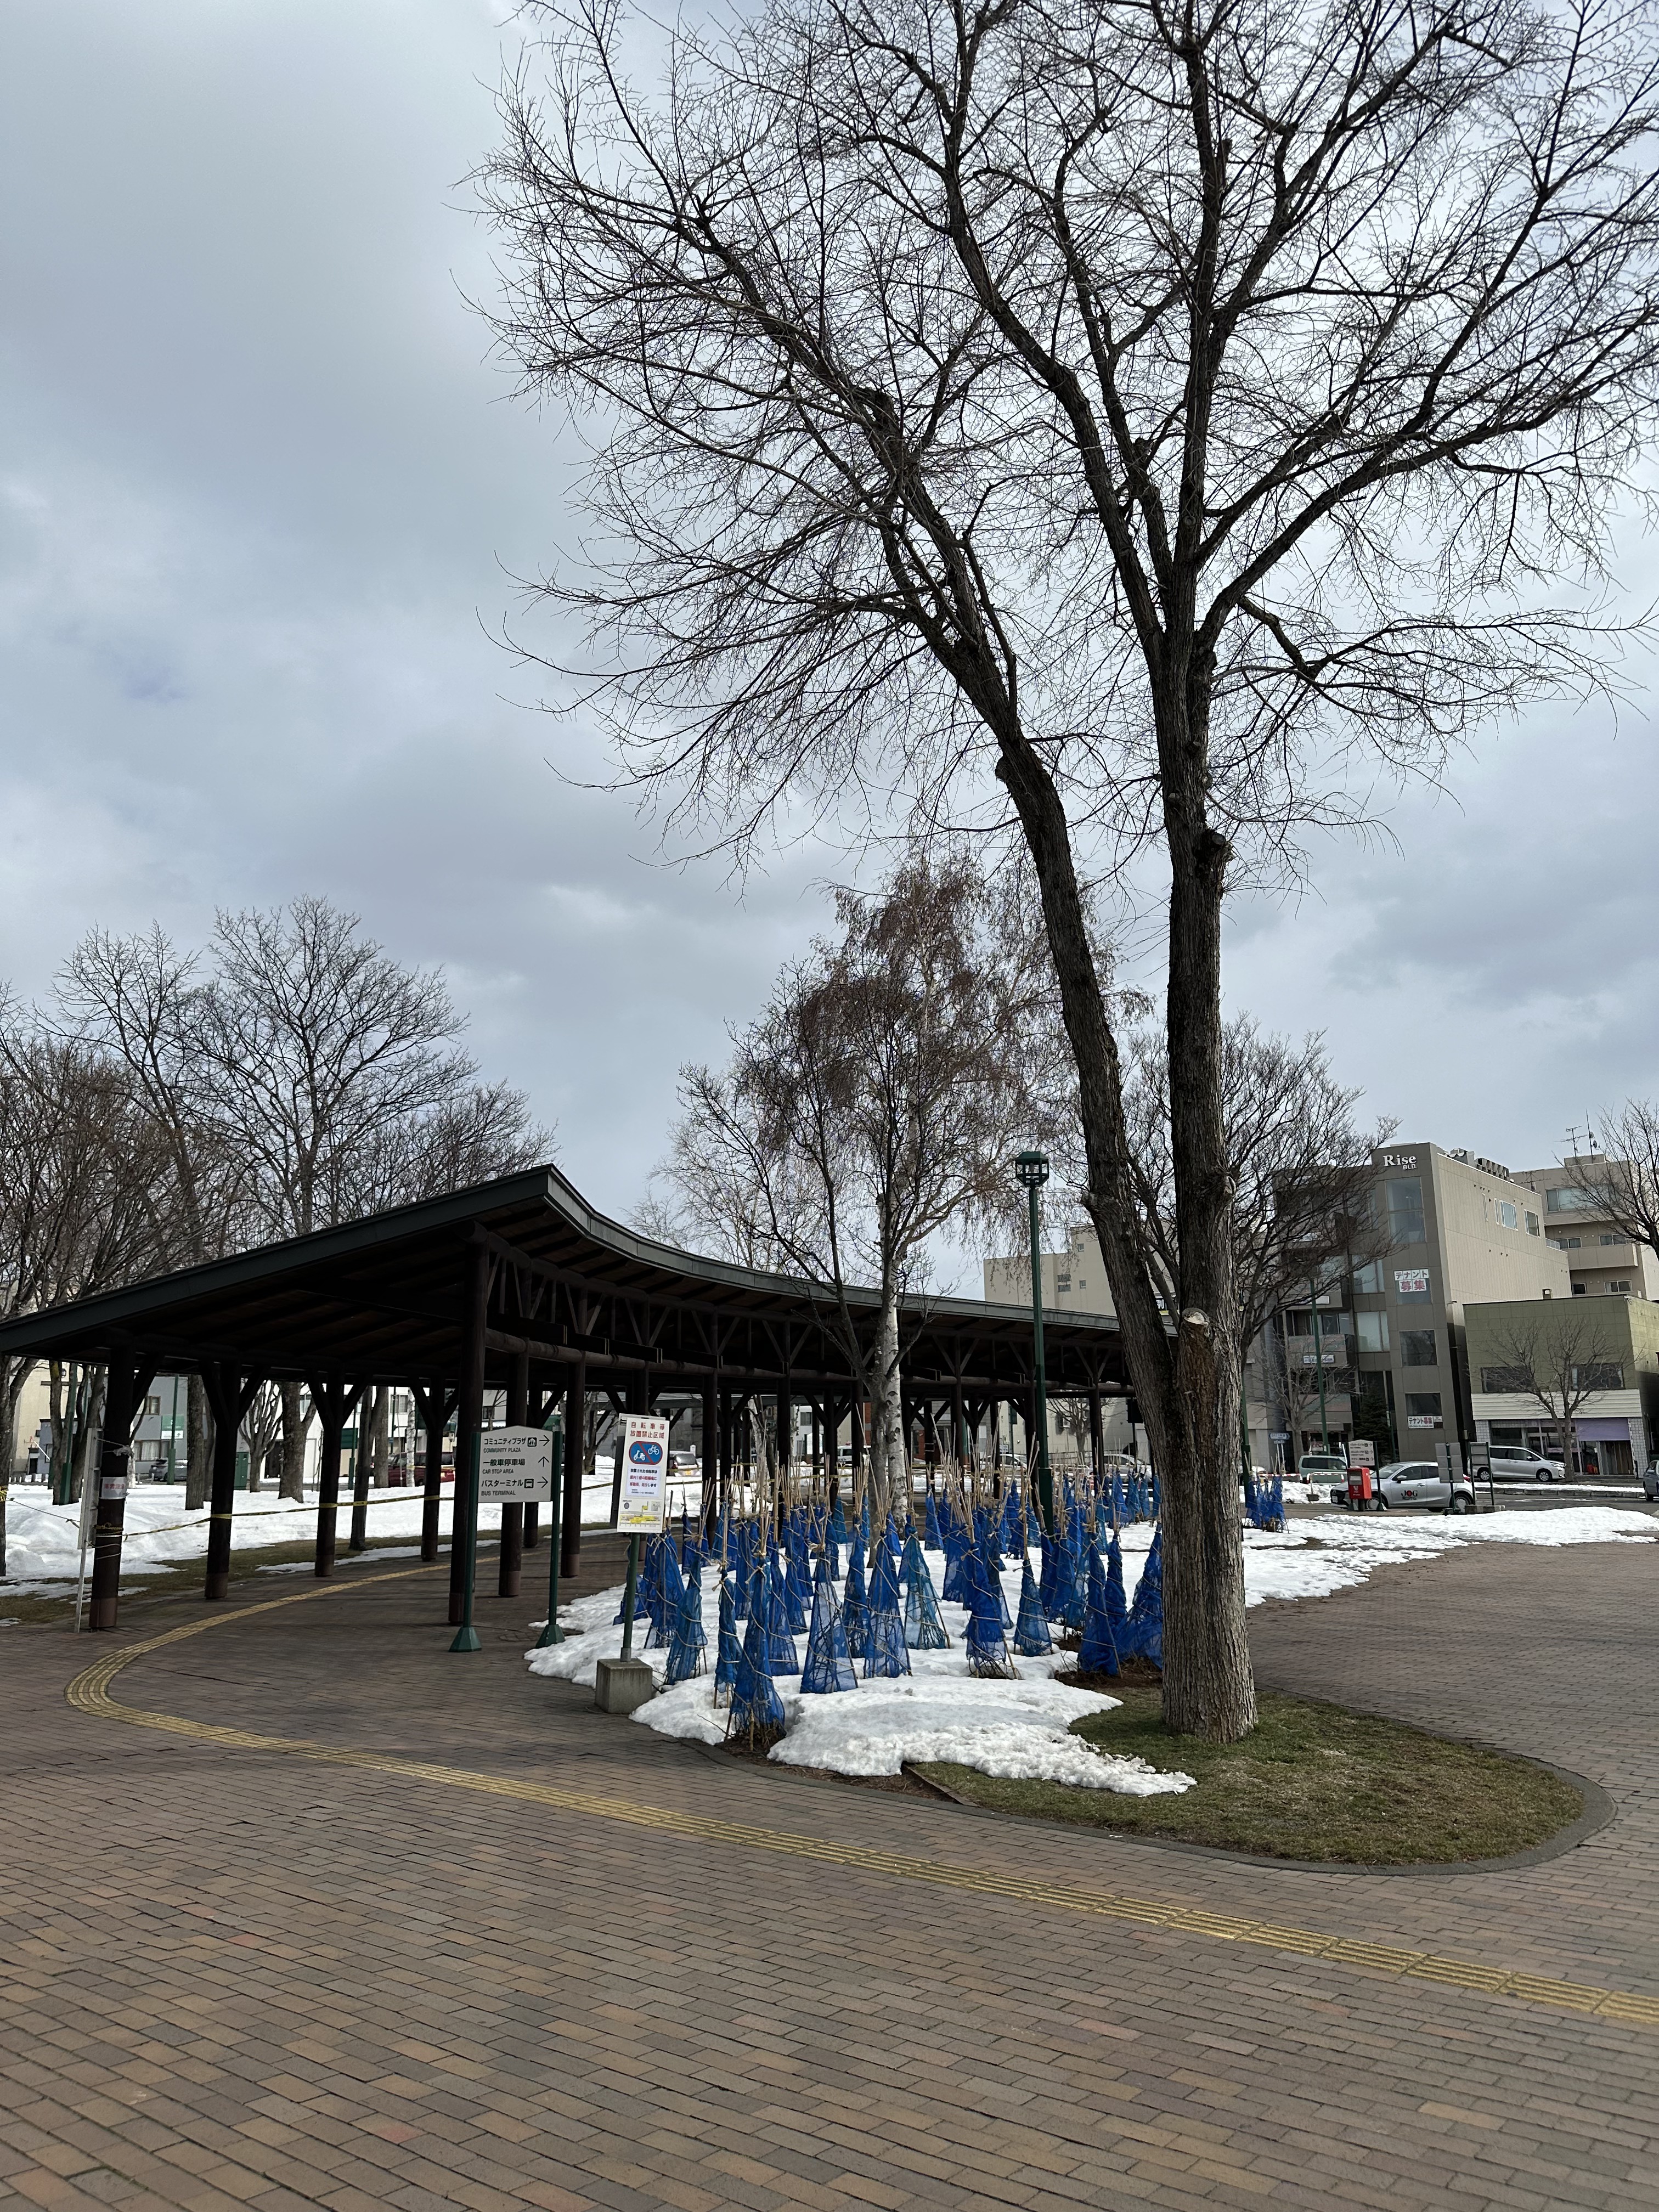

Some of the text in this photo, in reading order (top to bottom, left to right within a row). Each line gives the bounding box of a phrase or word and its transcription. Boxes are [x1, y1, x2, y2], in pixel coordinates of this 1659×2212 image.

[1383, 1154, 1417, 1166] Rise
[1396, 1270, 1427, 1279] テナント
[1400, 1280, 1425, 1291] 募集
[630, 1430, 664, 1438] 放置禁止区域
